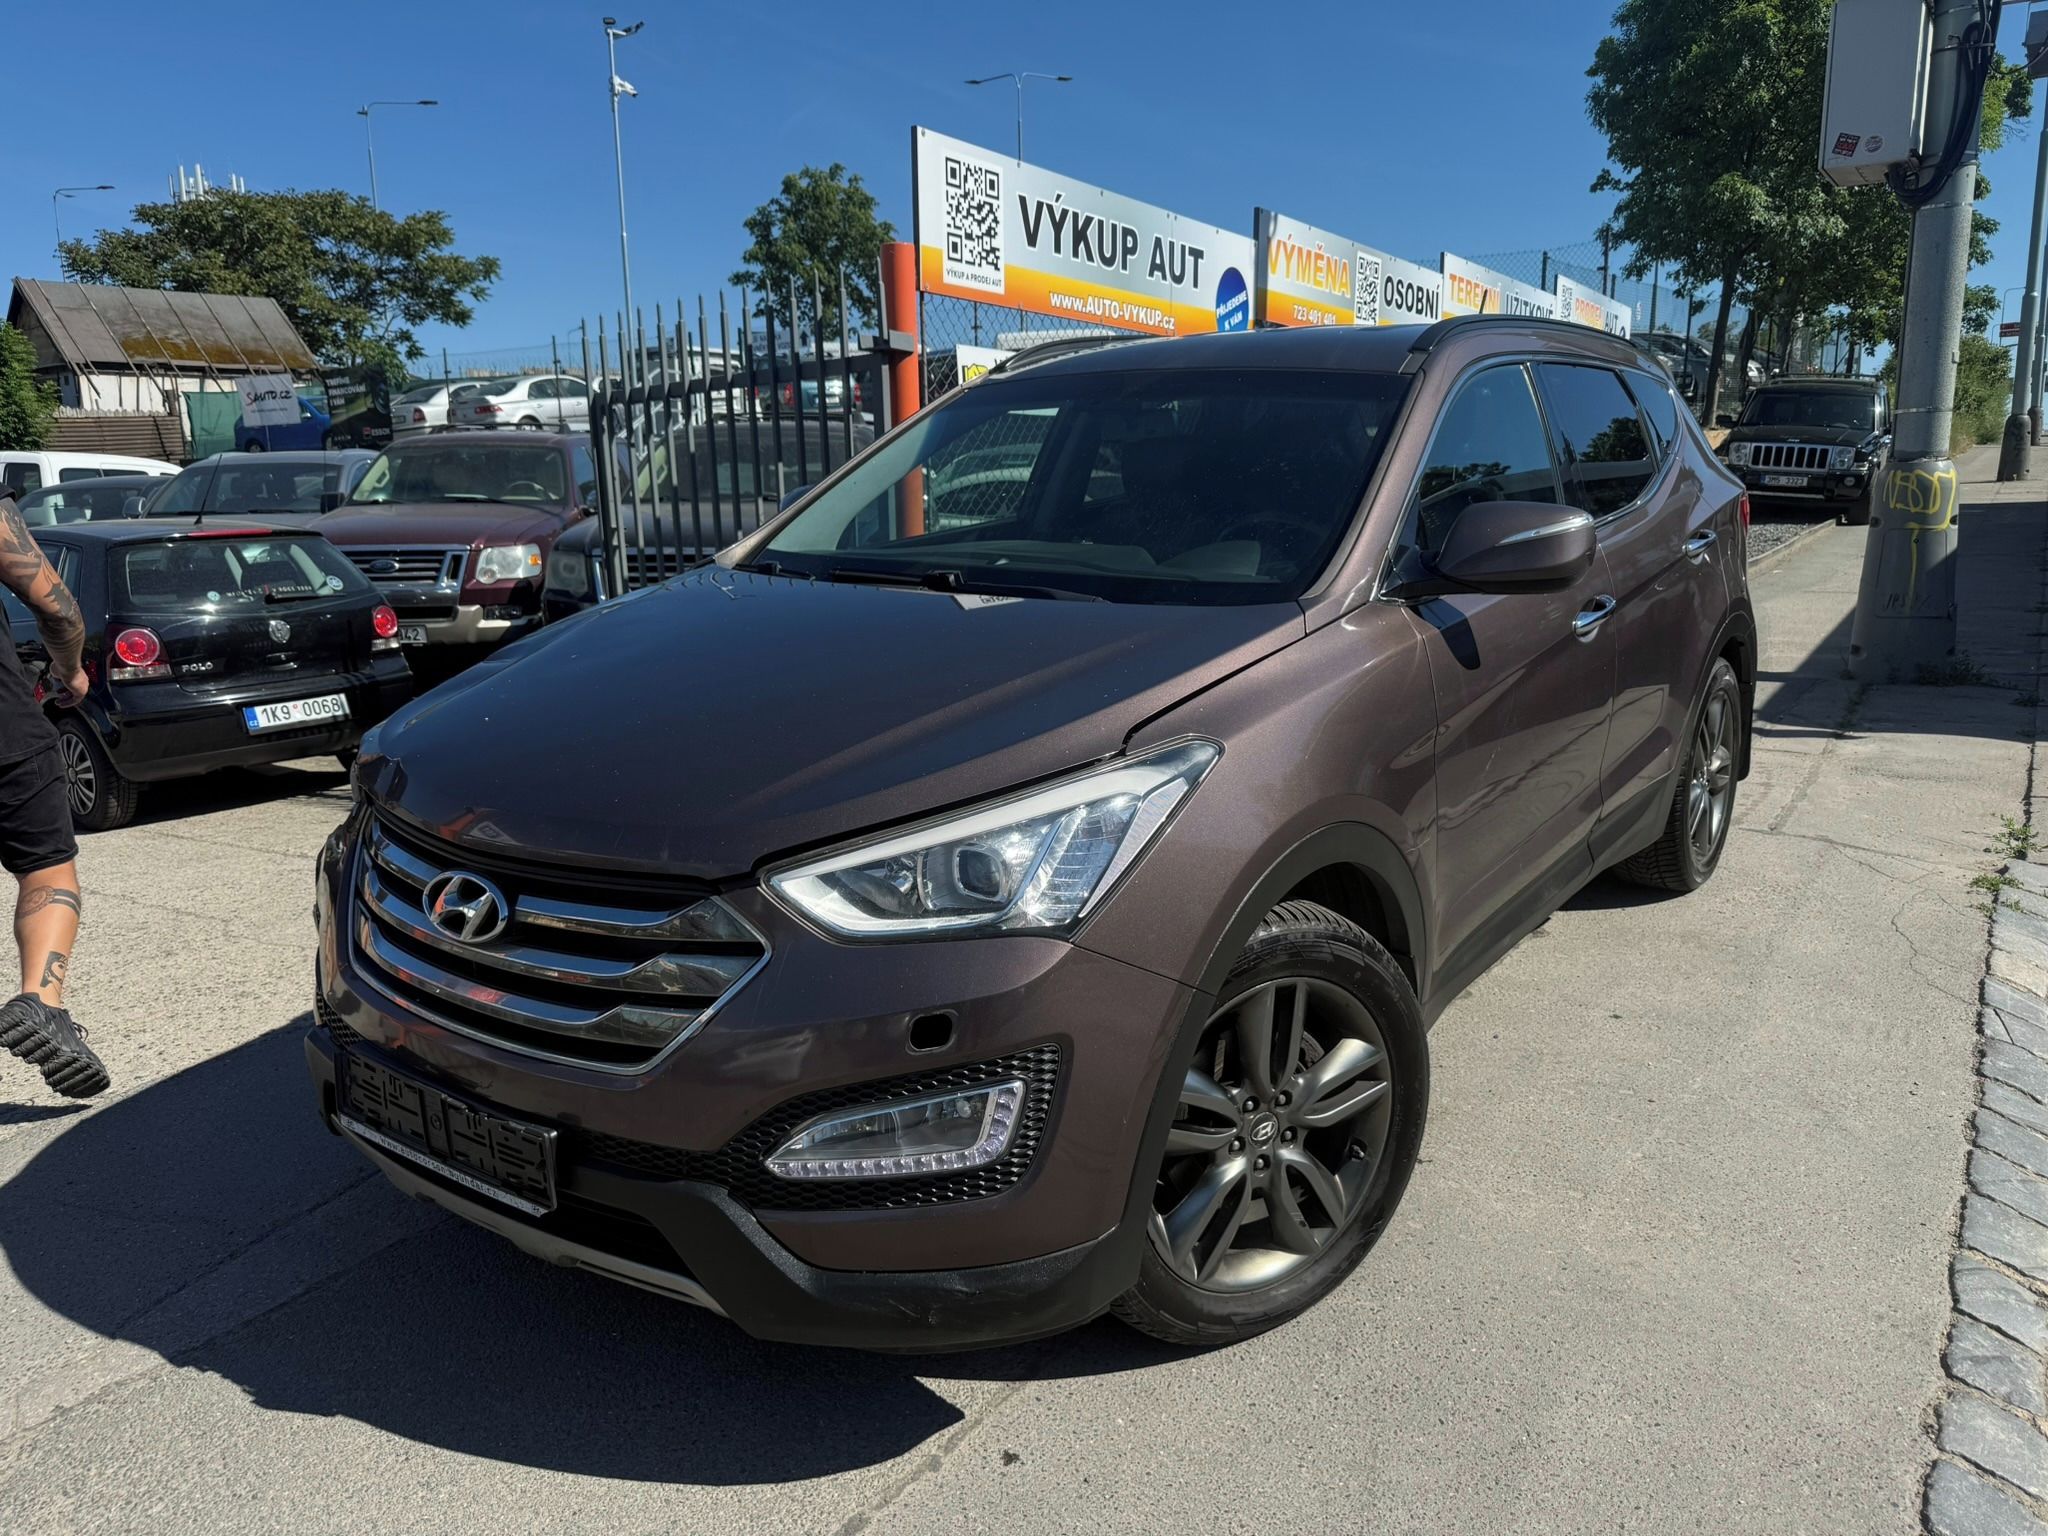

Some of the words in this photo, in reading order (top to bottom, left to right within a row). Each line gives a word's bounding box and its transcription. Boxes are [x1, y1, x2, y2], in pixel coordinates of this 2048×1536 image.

[1018, 193, 1139, 272] VÝKUP
[1148, 236, 1205, 289] AUT
[970, 273, 991, 285] PRODEJ
[1269, 234, 1350, 297] VÝMĚNA
[1050, 293, 1175, 330] www.AUTO-VYKUP.cz
[1384, 275, 1440, 320] OSOBNÍ
[1293, 304, 1307, 321] 723
[1308, 309, 1322, 325] 401
[181, 661, 214, 673] POLO
[261, 703, 291, 724] 1K9
[302, 697, 341, 717] 0068
